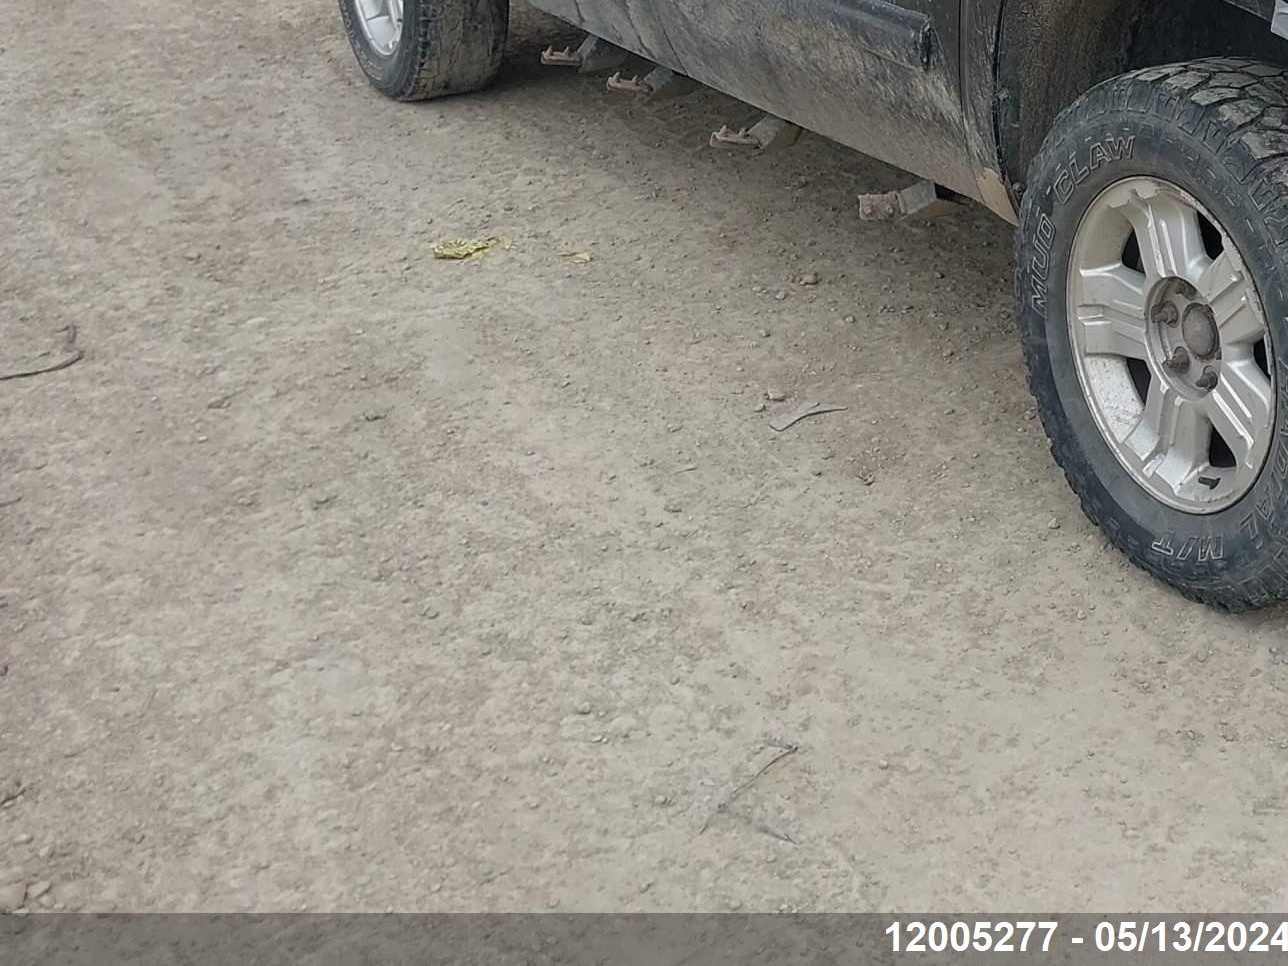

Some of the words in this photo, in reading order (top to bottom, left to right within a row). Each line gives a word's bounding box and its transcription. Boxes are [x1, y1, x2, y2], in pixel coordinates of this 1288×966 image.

[1031, 213, 1056, 319] MUD
[1054, 134, 1135, 204] CLAW
[1151, 536, 1225, 562] M/T
